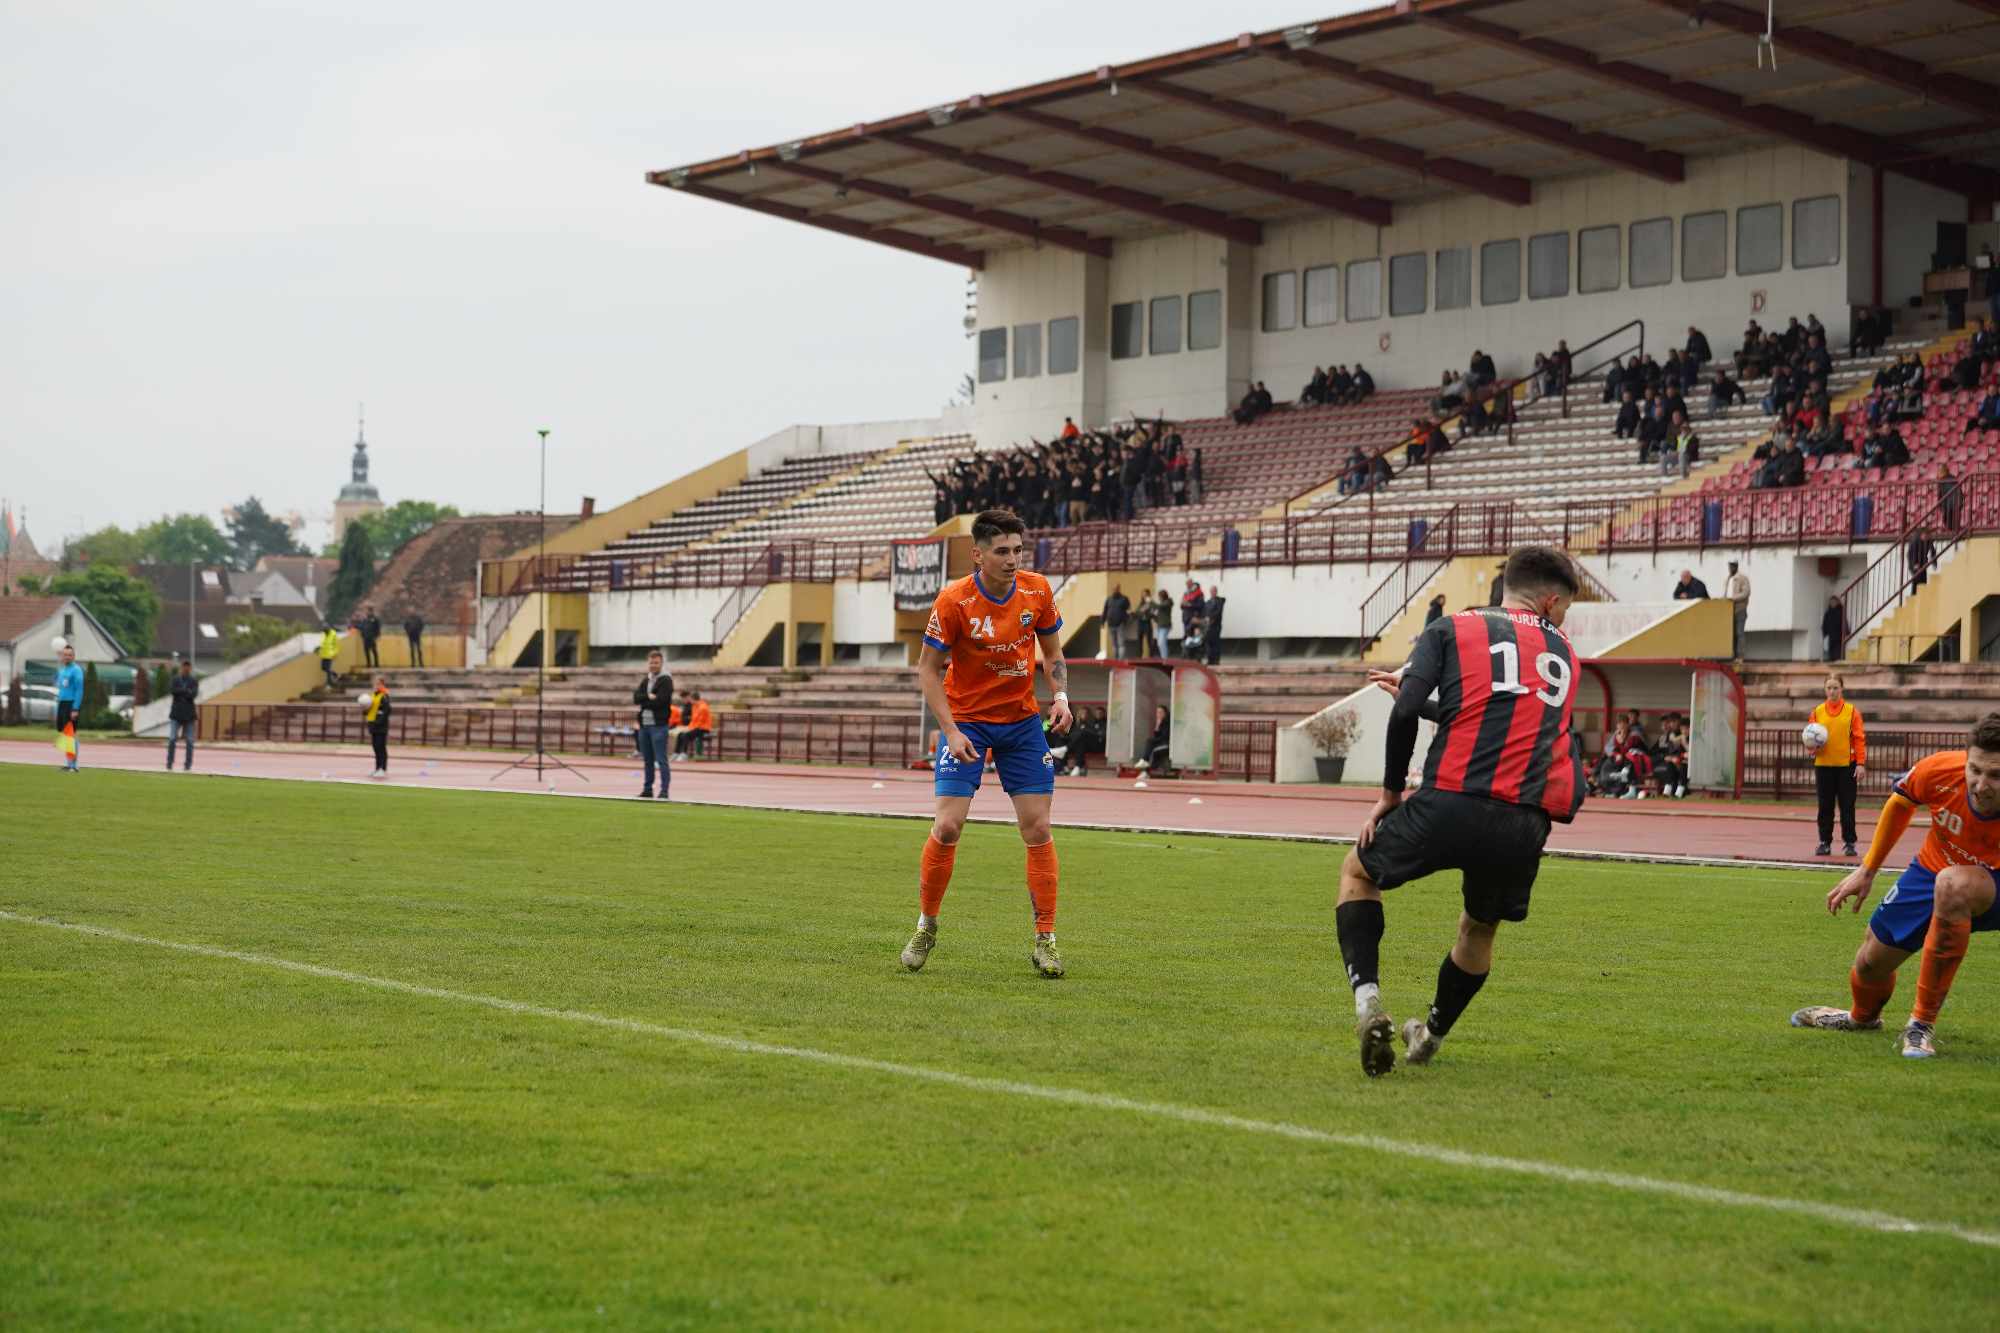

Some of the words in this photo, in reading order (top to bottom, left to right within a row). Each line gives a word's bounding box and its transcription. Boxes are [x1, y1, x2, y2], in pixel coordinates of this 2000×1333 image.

[1751, 290, 1766, 312] D
[969, 615, 995, 639] 24
[1489, 641, 1571, 708] 19
[1933, 808, 1962, 834] 30
